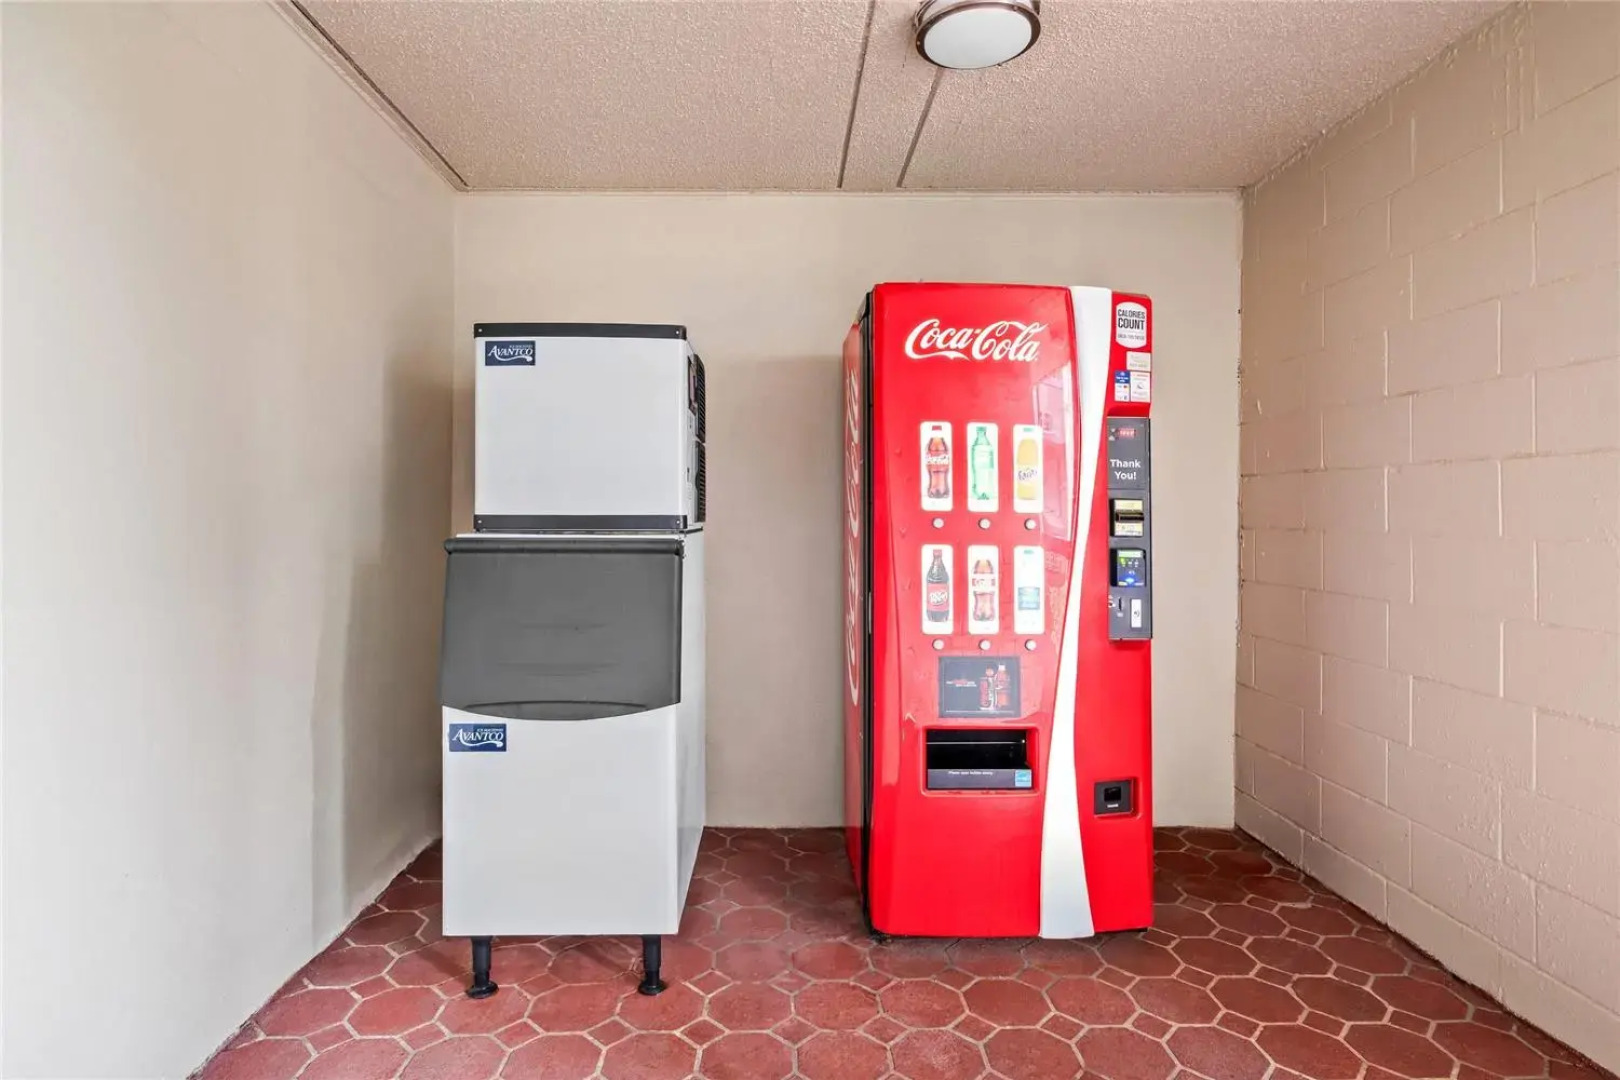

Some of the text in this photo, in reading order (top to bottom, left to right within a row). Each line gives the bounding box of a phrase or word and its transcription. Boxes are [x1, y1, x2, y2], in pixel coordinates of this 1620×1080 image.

[1117, 309, 1146, 319] CALORIES
[1117, 318, 1145, 330] COUNT
[904, 318, 1049, 362] Coca-Cola
[1109, 459, 1141, 468] Thank
[1114, 471, 1137, 480] You!
[452, 728, 504, 747] AVANTCO
